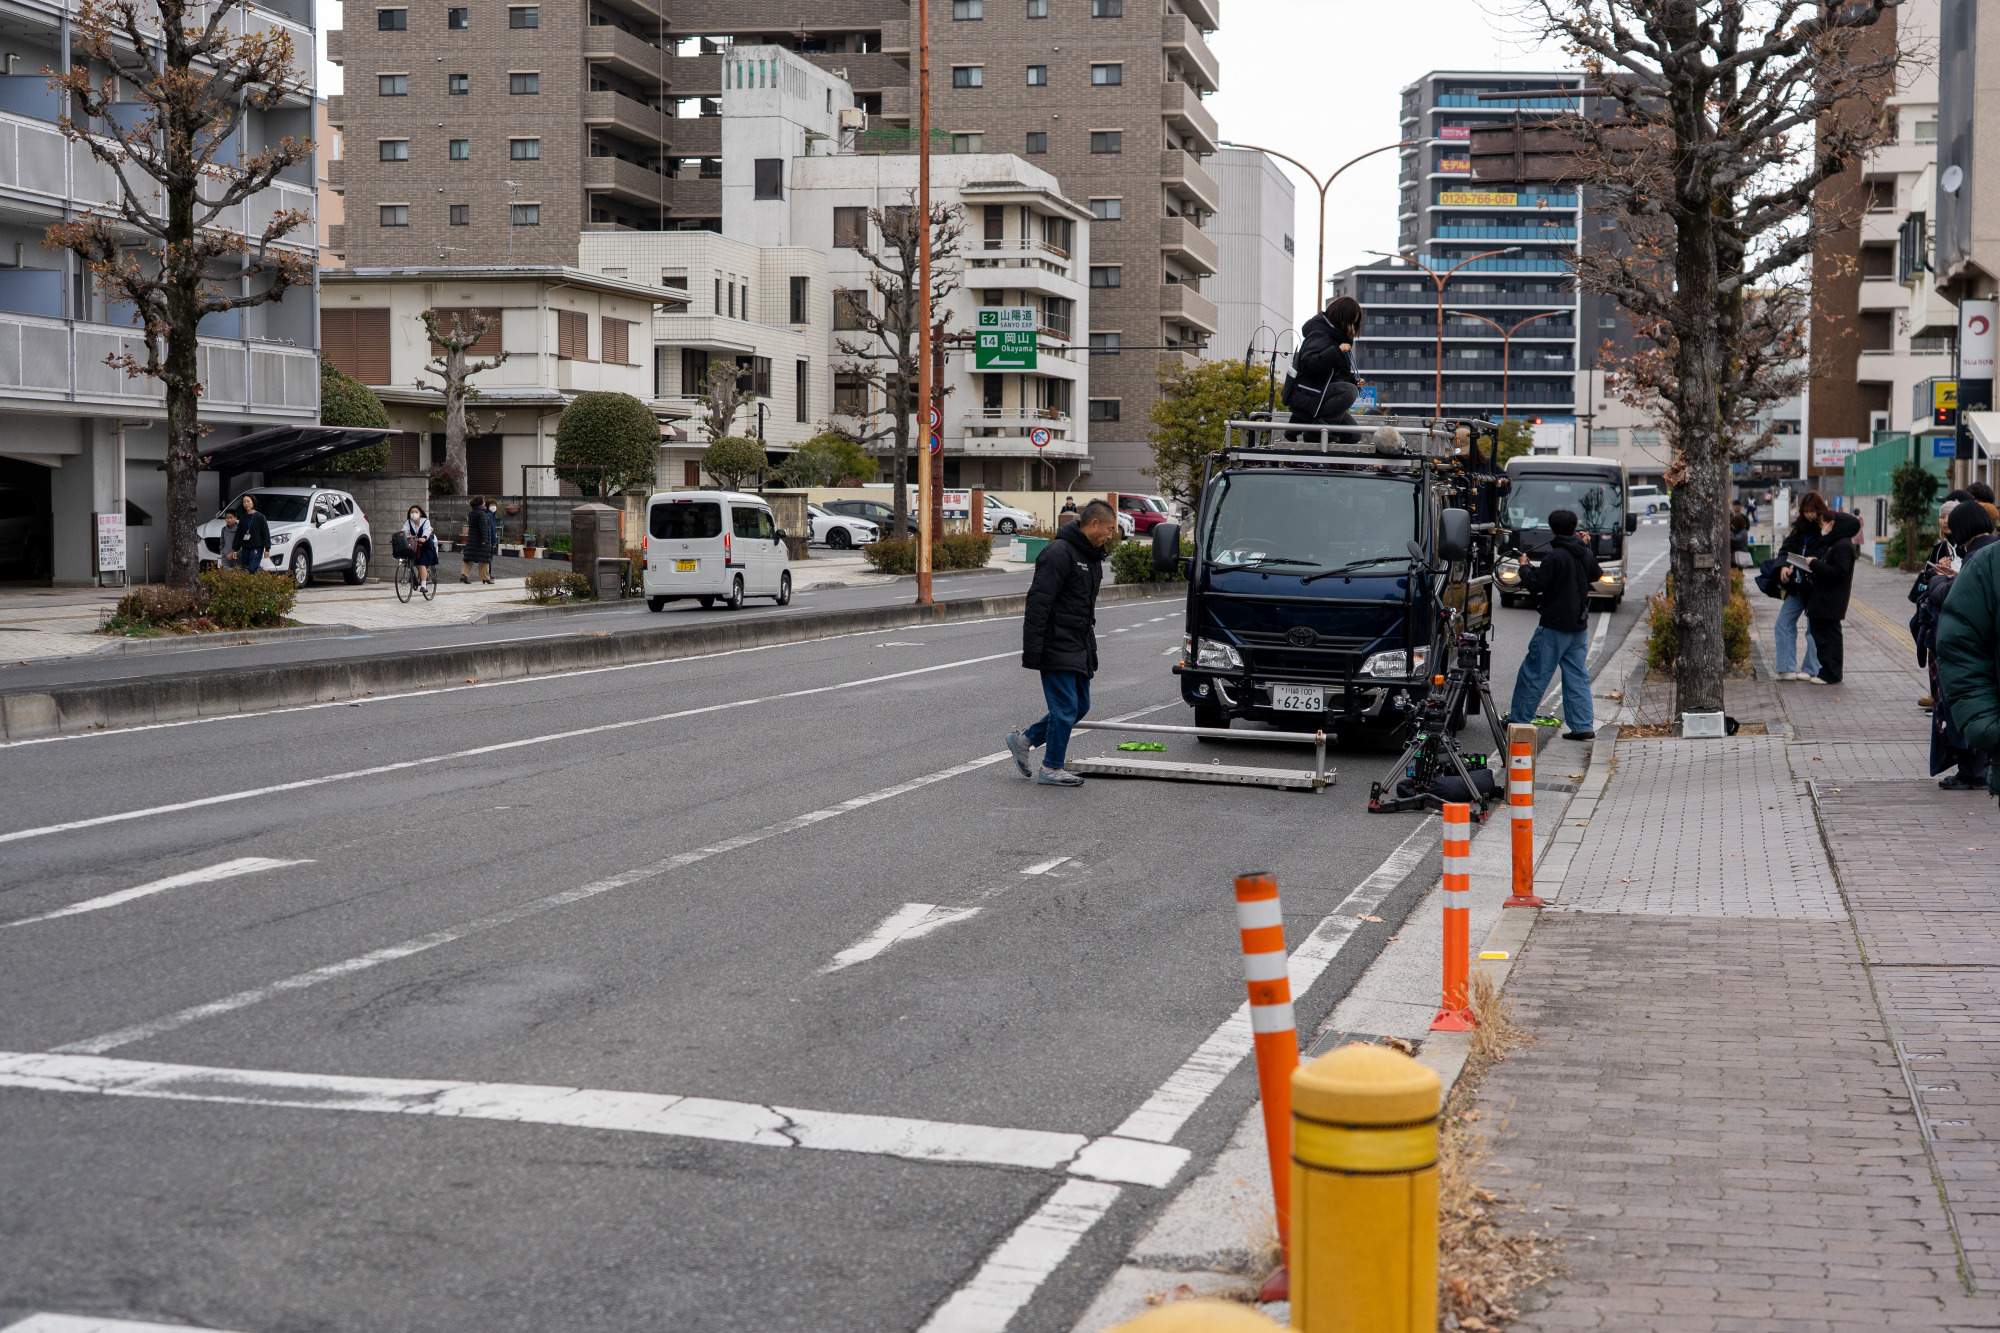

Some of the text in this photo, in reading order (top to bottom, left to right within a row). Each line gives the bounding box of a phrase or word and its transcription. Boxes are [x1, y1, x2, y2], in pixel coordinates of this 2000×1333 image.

[1442, 193, 1515, 204] 0120-766-087
[981, 314, 996, 324] E2
[1000, 309, 1033, 321] 山陽道
[982, 336, 996, 346] 14
[1004, 332, 1029, 344] 岡山
[1001, 345, 1033, 354] Okayama
[1284, 696, 1321, 710] 62-69
